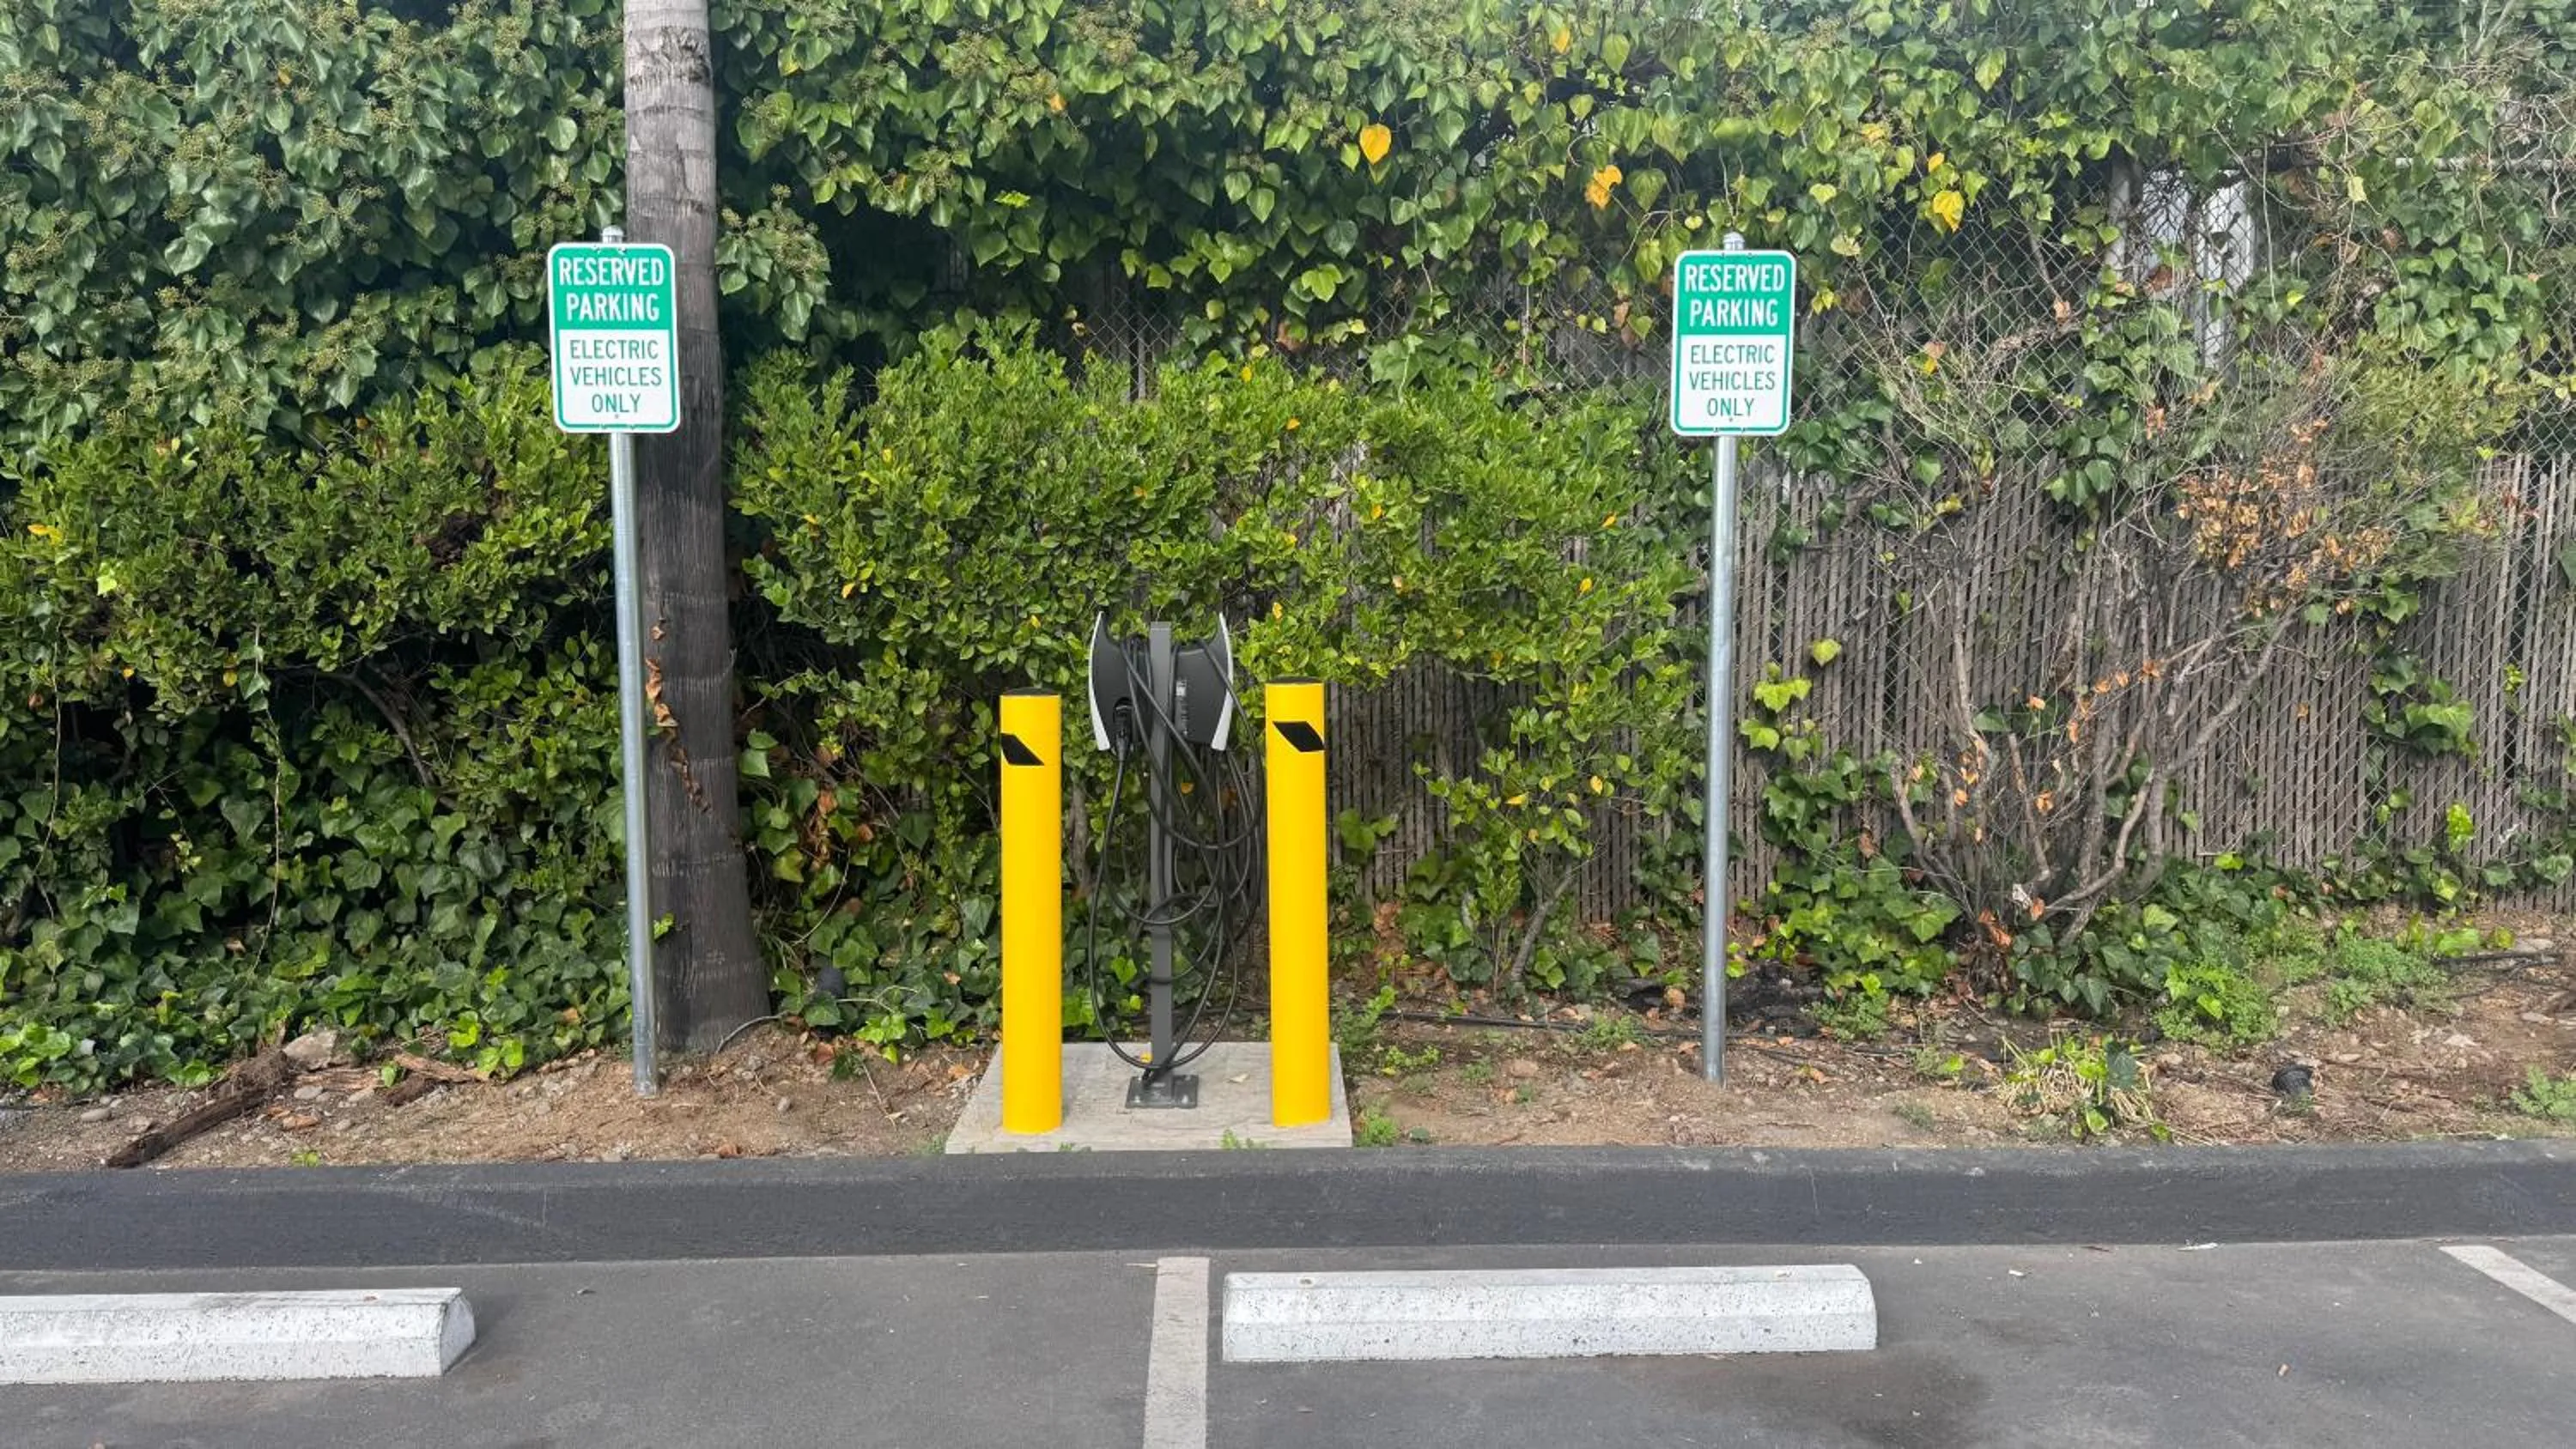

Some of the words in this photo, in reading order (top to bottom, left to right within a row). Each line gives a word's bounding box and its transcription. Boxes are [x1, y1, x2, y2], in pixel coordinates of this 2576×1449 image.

[559, 257, 665, 286] RESERVED
[1685, 264, 1785, 293] RESERVED
[566, 293, 660, 322] PARKING
[1689, 298, 1778, 327] PARKING
[569, 339, 659, 360] ELECTRIC
[1690, 344, 1775, 365] ELECTRIC
[569, 367, 662, 386] VEHICLES
[1689, 371, 1776, 391] VEHICLES
[592, 393, 641, 413] ONLY
[1706, 397, 1754, 417] ONLY
